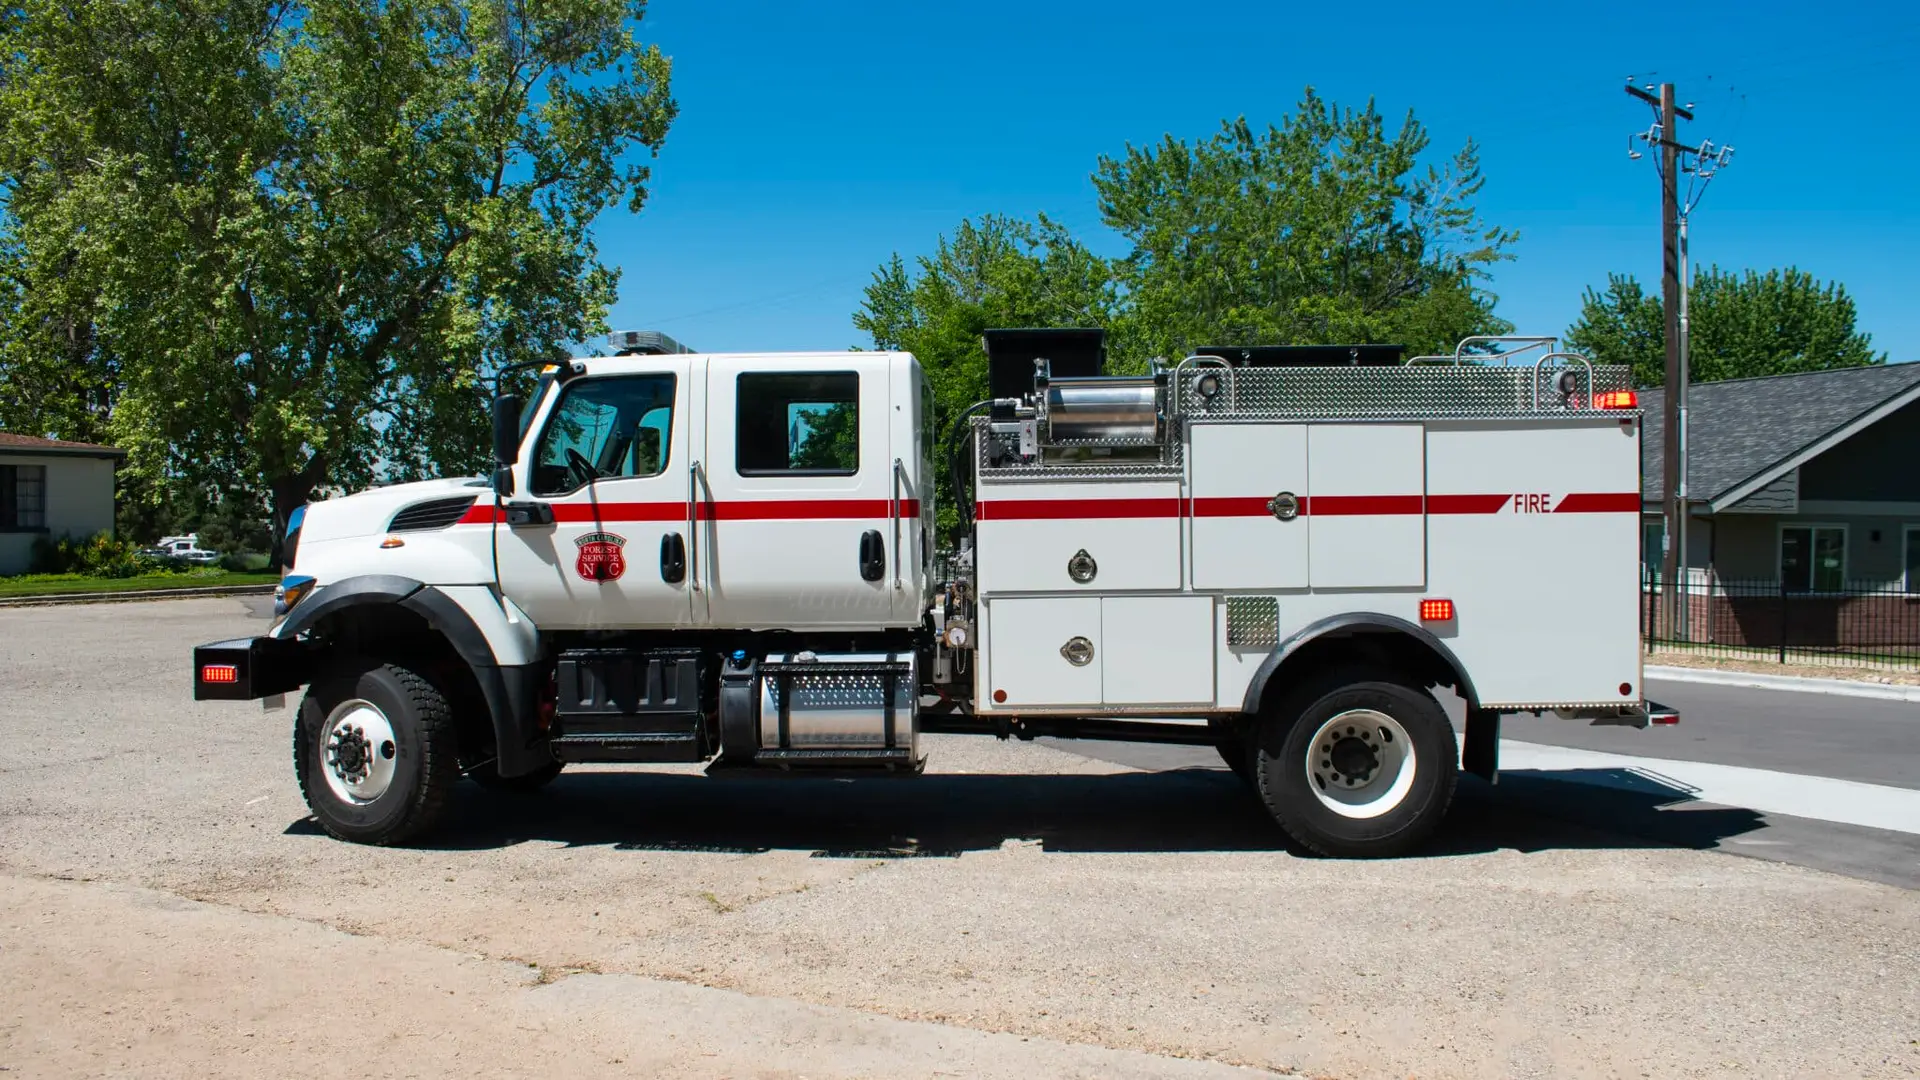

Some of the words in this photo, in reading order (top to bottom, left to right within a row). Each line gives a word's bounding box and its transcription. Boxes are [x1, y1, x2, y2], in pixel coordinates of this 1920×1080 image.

[1514, 493, 1551, 513] FIRE
[583, 546, 617, 554] FOREST
[582, 554, 619, 562] SERVICE
[583, 563, 595, 576] N
[609, 562, 620, 576] C
